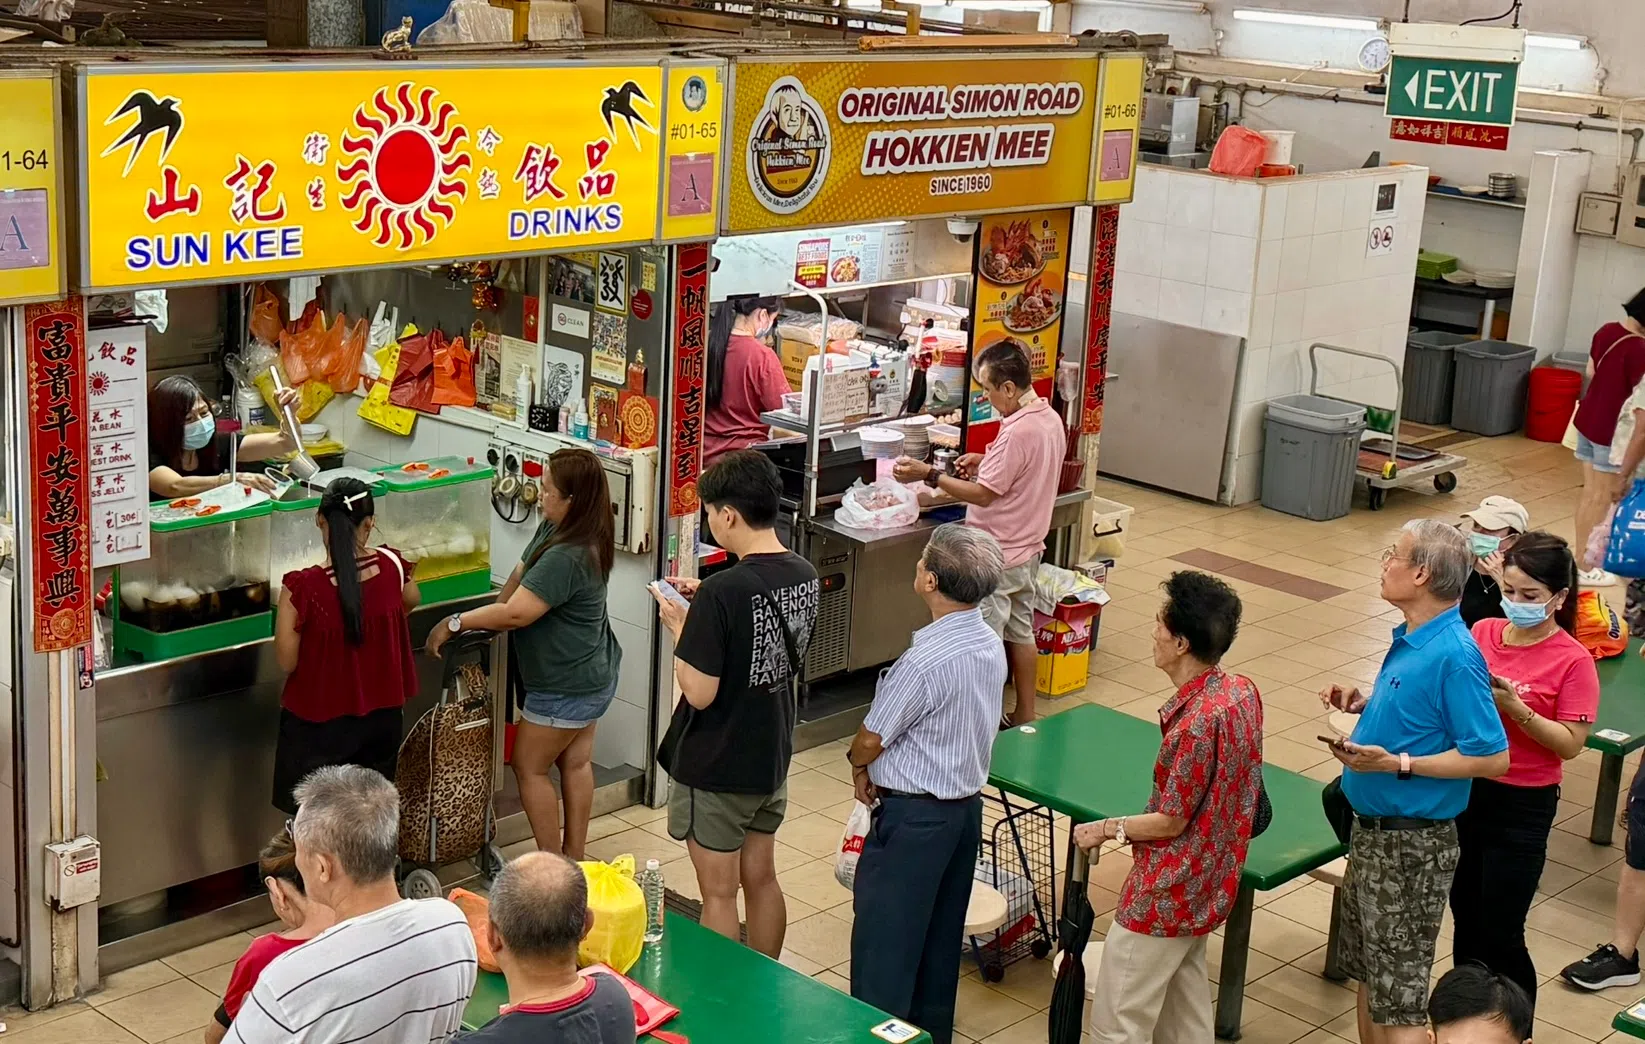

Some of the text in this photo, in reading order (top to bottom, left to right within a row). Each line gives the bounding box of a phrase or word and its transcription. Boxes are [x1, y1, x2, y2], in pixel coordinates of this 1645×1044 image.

[841, 84, 1081, 118] ORIGINAL SIMON ROAD
[1423, 69, 1503, 113] EXIT
[1104, 103, 1137, 119] #01-66
[671, 122, 717, 140] #01-65
[866, 126, 1050, 170] HOKKIEN MEE
[515, 138, 618, 203] 飲品
[681, 173, 701, 201] A
[930, 173, 991, 195] SINCE 1960
[145, 156, 287, 223] 山記
[0, 214, 29, 251] A
[509, 205, 623, 238] DRINKS
[128, 226, 303, 270] SUN KEE
[99, 421, 122, 432] BEAN
[37, 318, 82, 608] 富貴平安萬事興
[108, 453, 132, 464] DRINK
[104, 486, 126, 495] JELLY
[120, 512, 137, 523] 30¢
